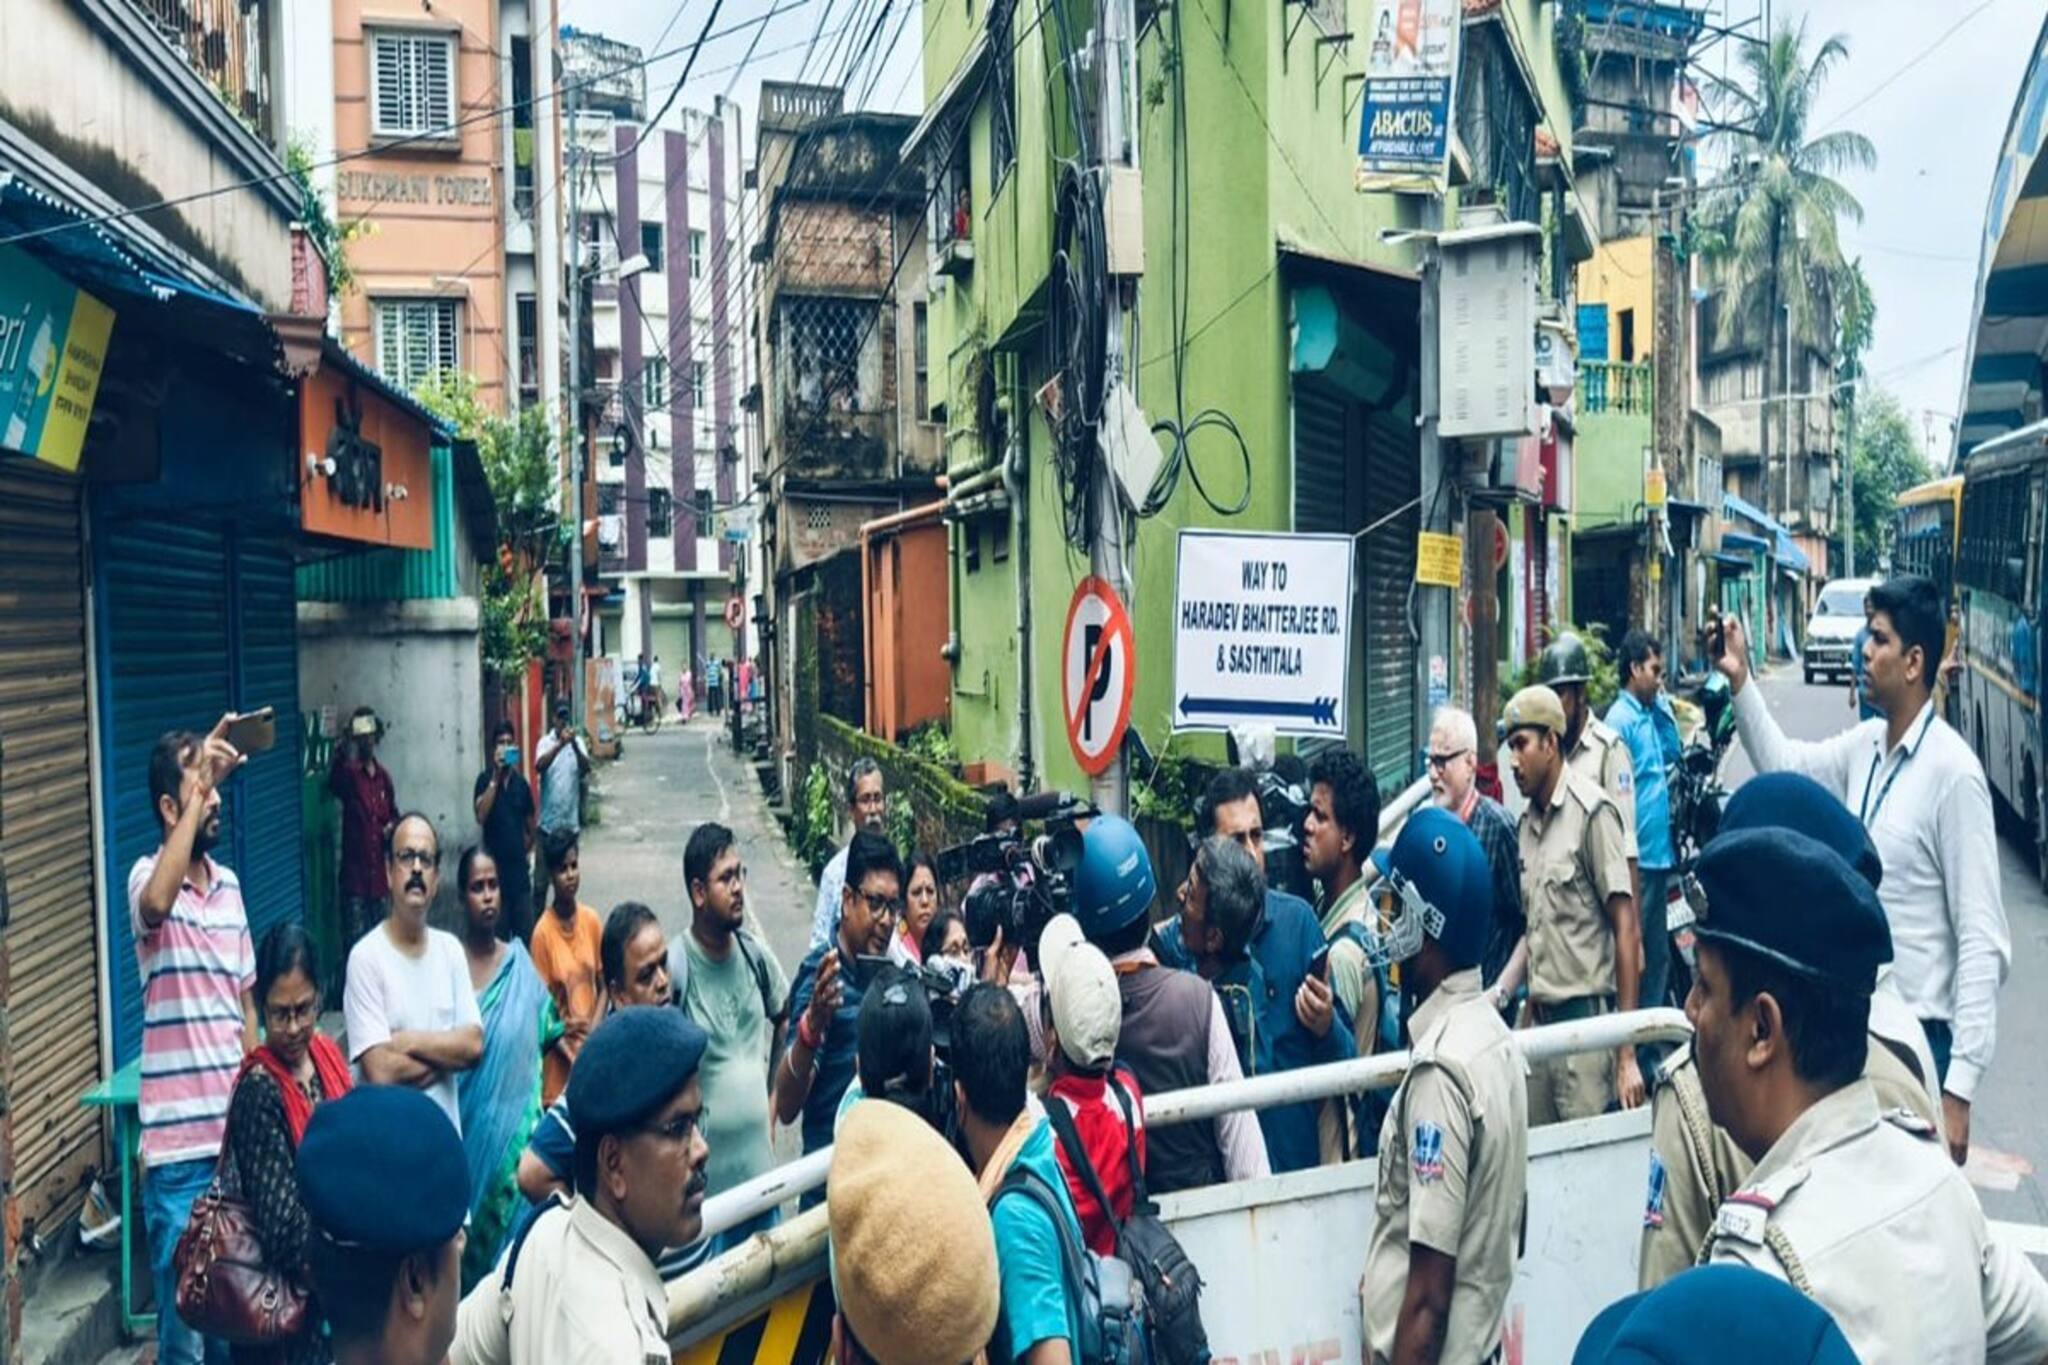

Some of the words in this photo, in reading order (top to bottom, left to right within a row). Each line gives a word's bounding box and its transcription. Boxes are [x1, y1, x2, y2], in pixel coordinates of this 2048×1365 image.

[1370, 109, 1433, 140] ABACUS
[435, 175, 492, 205] TOWER
[1242, 561, 1268, 591] WAY
[1272, 561, 1288, 592] TO
[1182, 601, 1240, 632] HARADEV
[1242, 604, 1319, 635] BHATTERJEE
[1322, 607, 1341, 636] RD.
[1216, 643, 1225, 673] &
[1228, 645, 1303, 676] SASTHITALA
